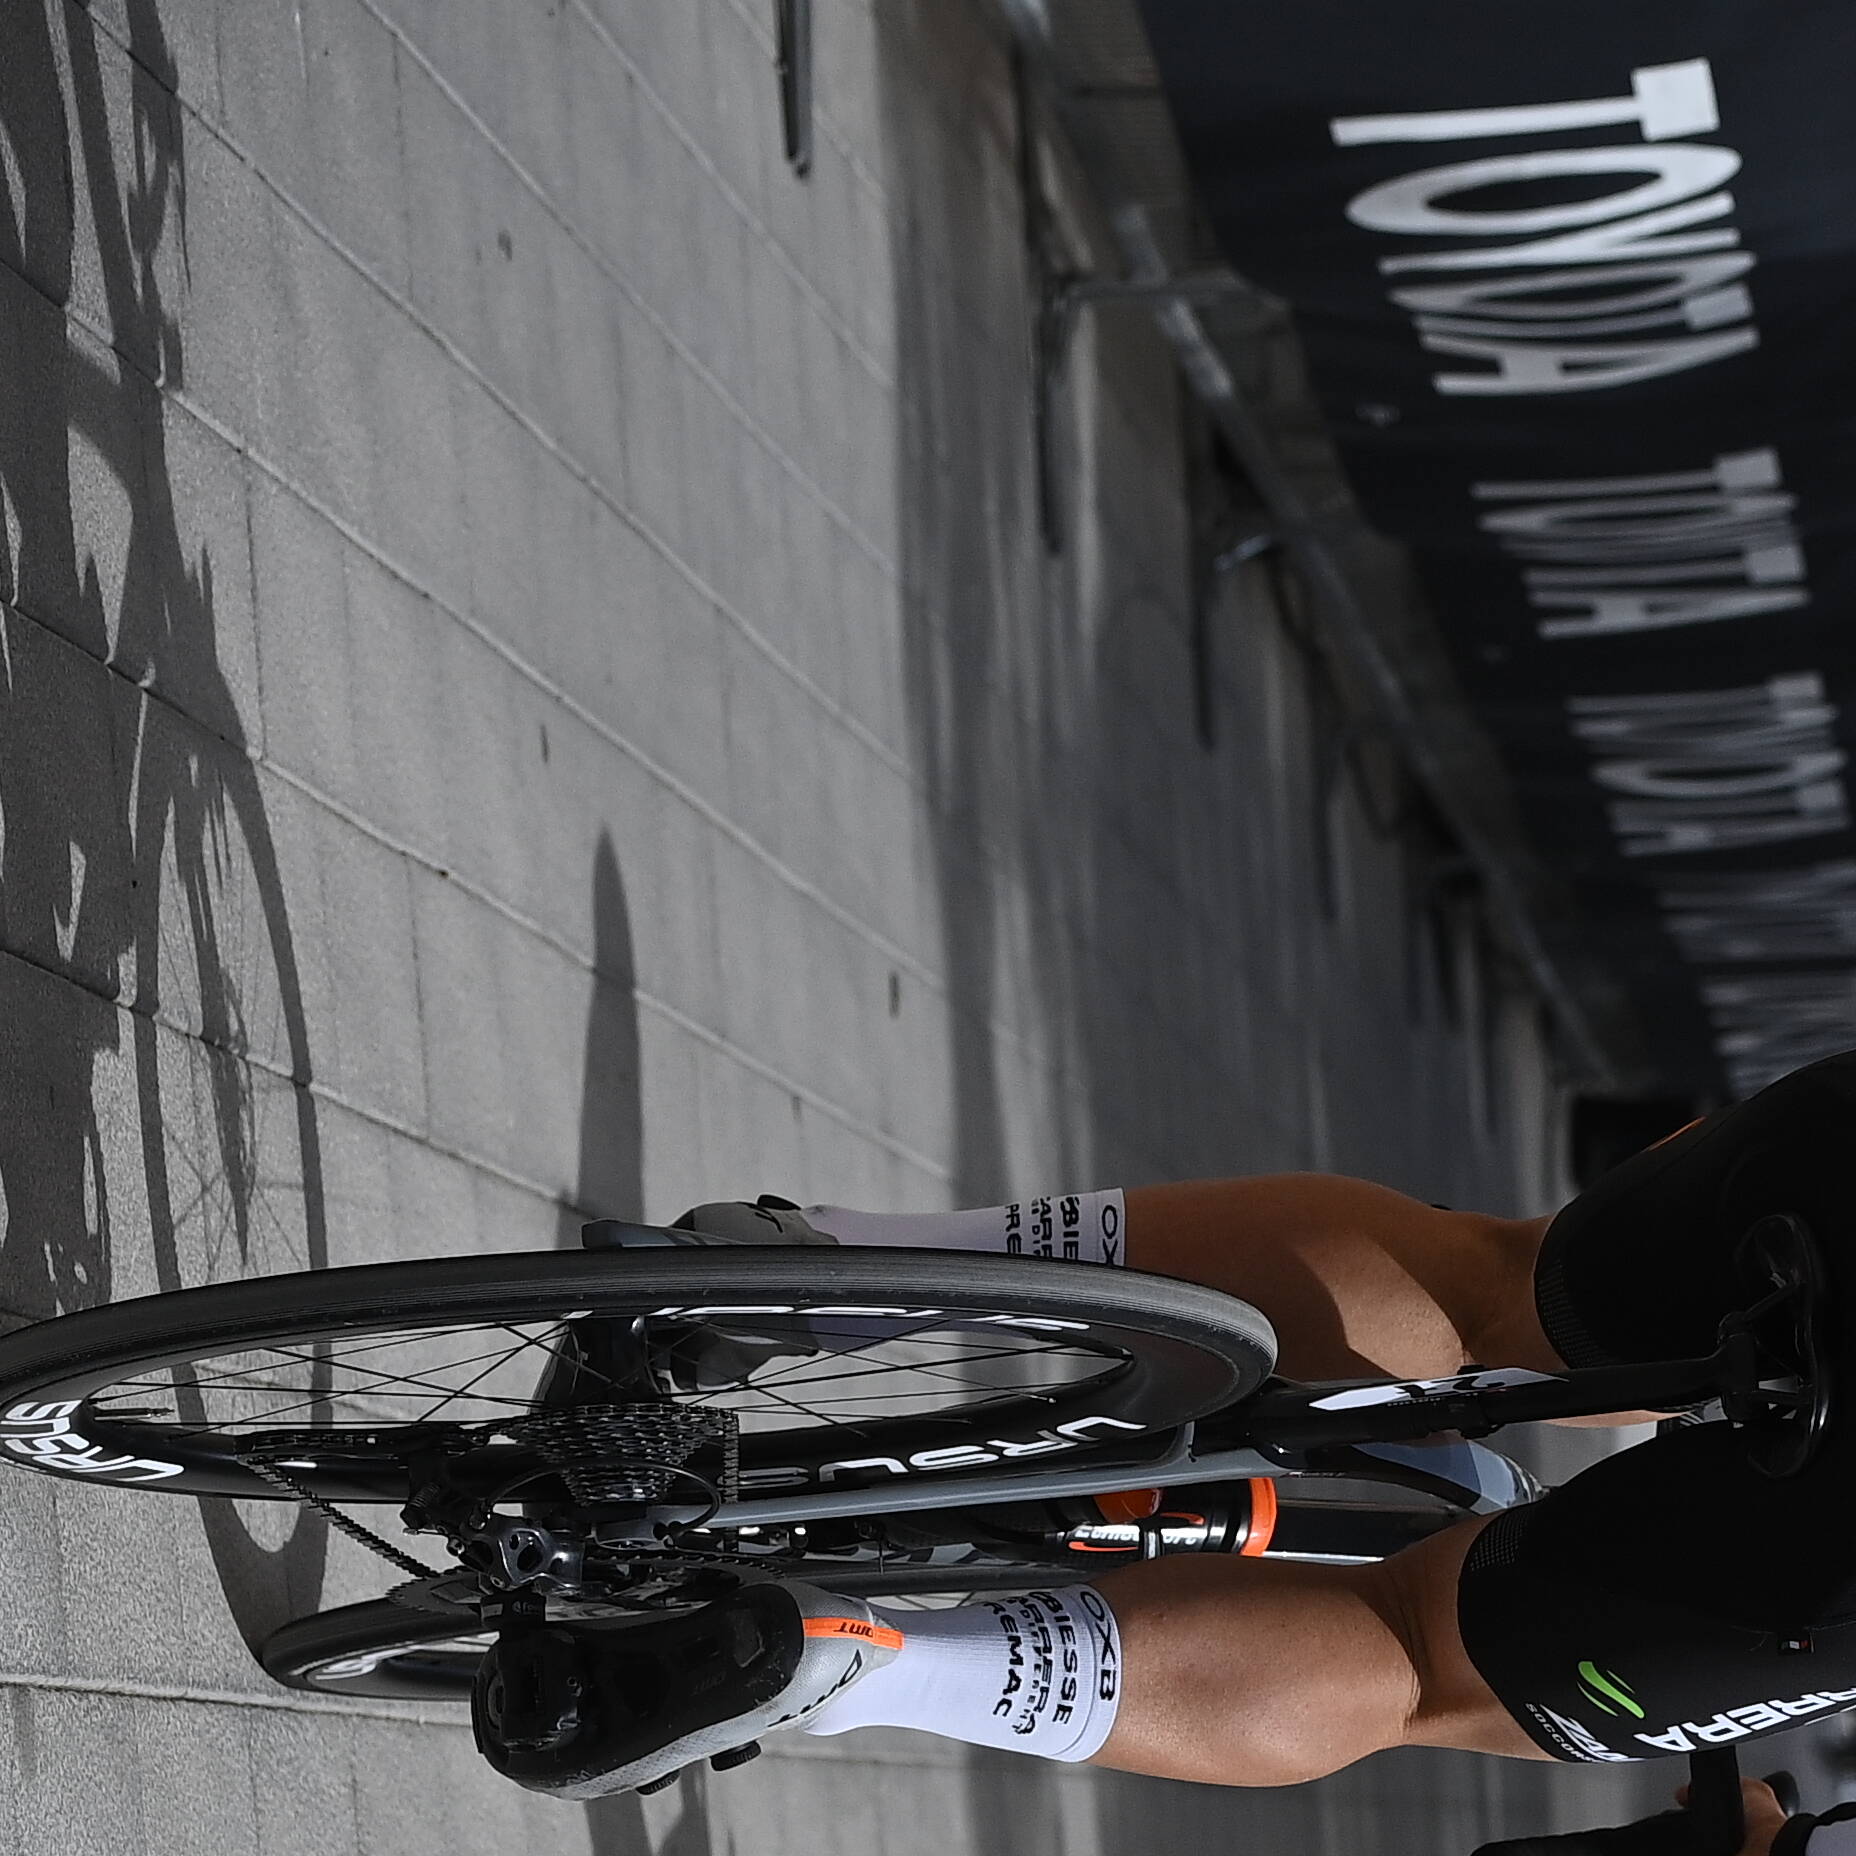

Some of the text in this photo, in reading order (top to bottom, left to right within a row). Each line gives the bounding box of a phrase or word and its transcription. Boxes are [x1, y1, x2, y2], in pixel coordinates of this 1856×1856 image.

[1328, 58, 1760, 396] TOYOTA
[1101, 1205, 1118, 1264] OX
[0, 1399, 185, 1483] URSUS
[983, 1602, 1024, 1717] REMAC
[1027, 1592, 1078, 1725] BIESSE
[1079, 1591, 1116, 1702] OXB
